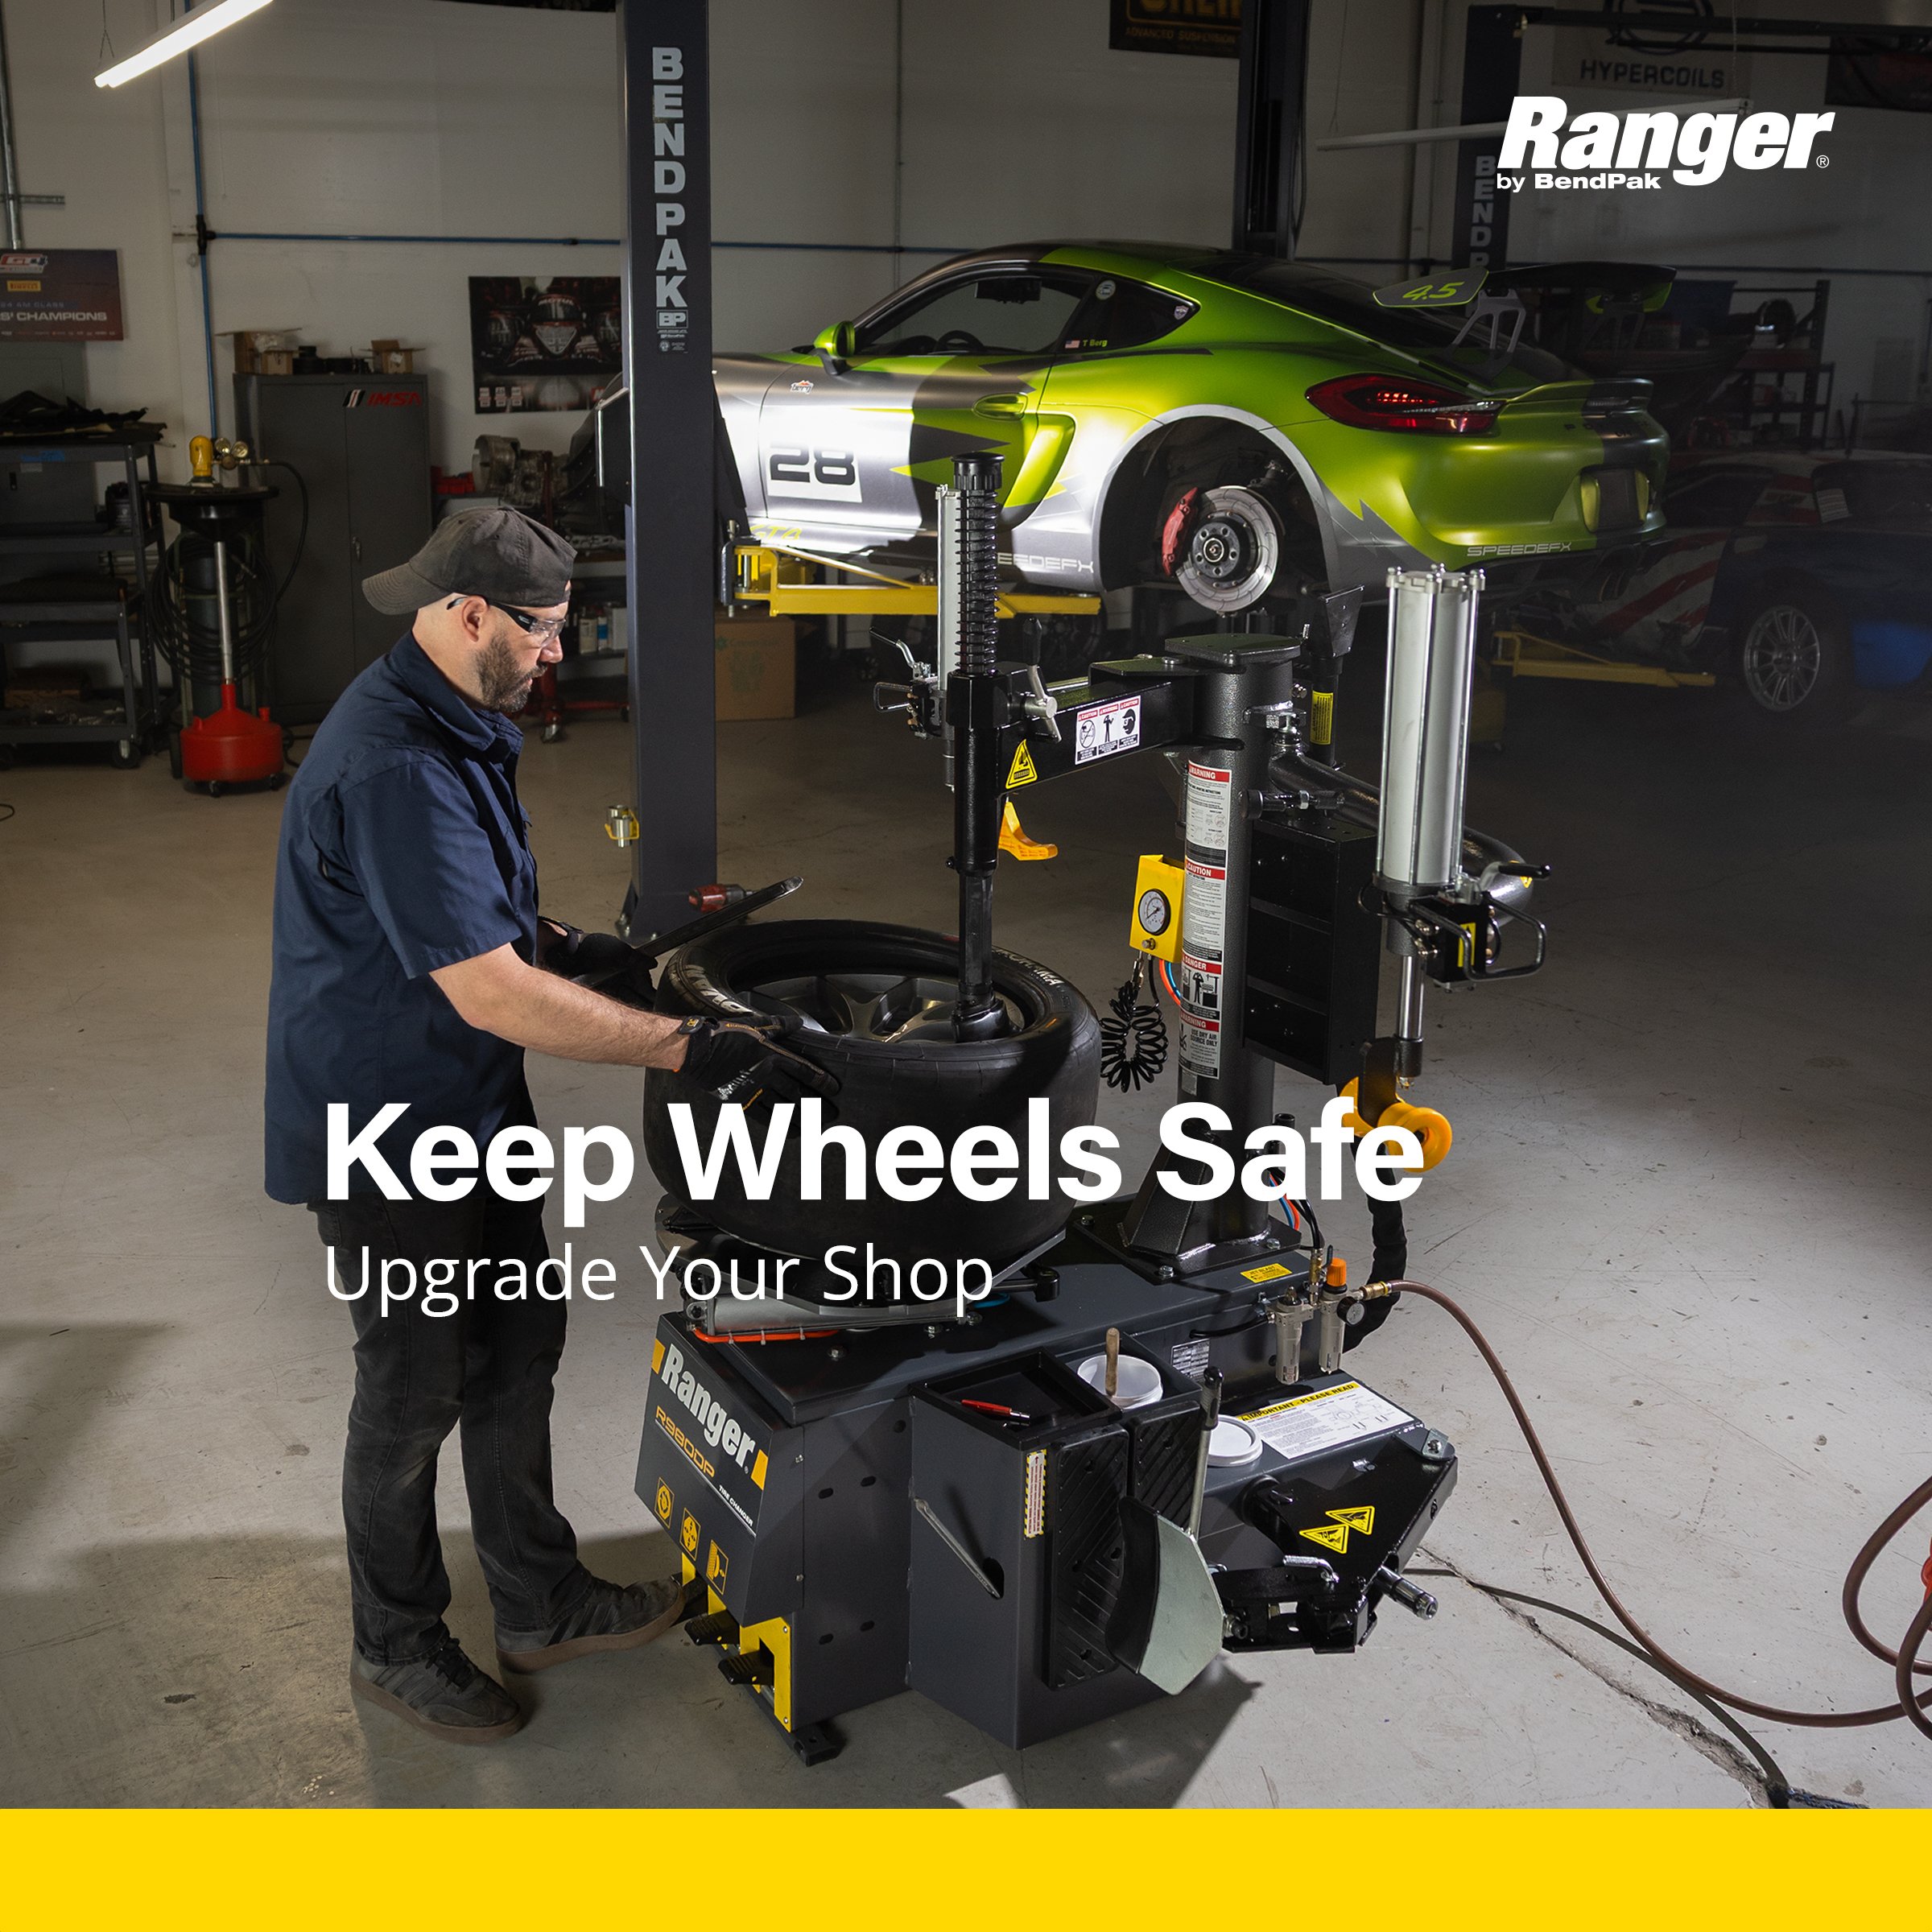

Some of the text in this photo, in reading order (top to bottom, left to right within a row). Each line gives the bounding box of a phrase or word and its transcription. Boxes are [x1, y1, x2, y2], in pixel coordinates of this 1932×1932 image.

[1125, 27, 1174, 39] ADVANCED
[1580, 59, 1725, 89] HYPERCOILS
[652, 47, 687, 308] BENDPAK
[1469, 155, 1496, 268] BENDP
[1402, 282, 1464, 300] 4.5
[16, 312, 108, 321] CHAMPIONS
[658, 312, 687, 327] BP
[1089, 339, 1108, 347] Berg
[366, 392, 423, 407] IMSA
[770, 443, 856, 485] 28
[1467, 542, 1572, 556] SPEEDEFX
[997, 552, 1094, 573] EEDEFX
[1187, 863, 1212, 877] CAUTION
[1186, 956, 1207, 971] DANGER
[1199, 1030, 1208, 1039] DRY
[661, 1344, 755, 1468] Ranger
[1249, 1402, 1294, 1420] IMPORTANT
[1301, 1390, 1331, 1404] PLEASE
[1332, 1384, 1354, 1397] READ
[718, 1485, 753, 1527] TIRE CHANGER
